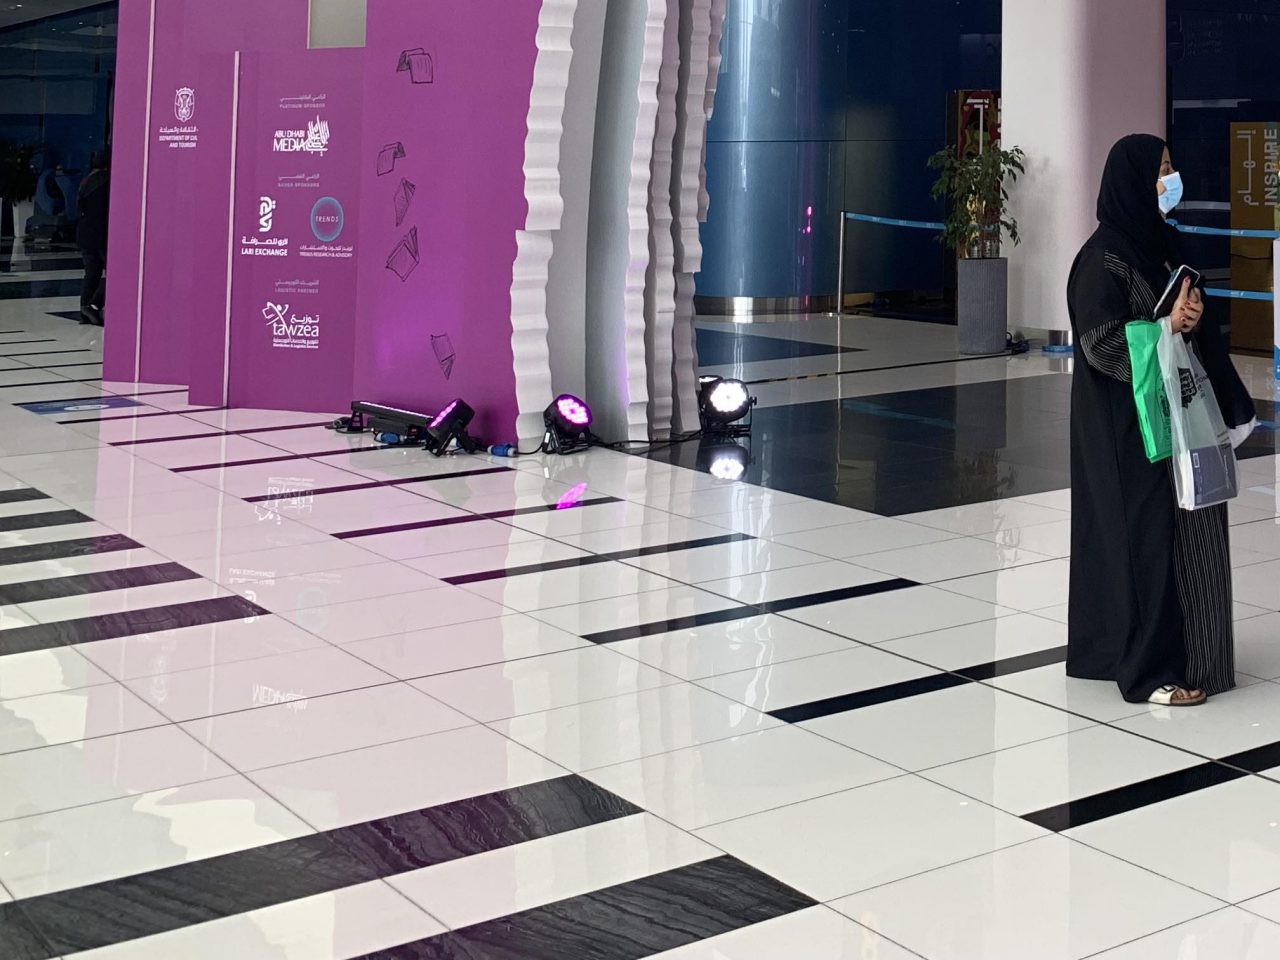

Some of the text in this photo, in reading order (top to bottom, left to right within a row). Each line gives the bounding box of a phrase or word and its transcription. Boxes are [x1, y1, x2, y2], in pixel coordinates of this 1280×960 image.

[274, 130, 305, 138] ABU DHABI
[273, 138, 306, 152] MEDIA
[1264, 129, 1278, 206] INSPIRE
[241, 247, 288, 257] LARI EXCHANGE
[290, 314, 320, 324] توزيع
[273, 322, 320, 338] tawzea
